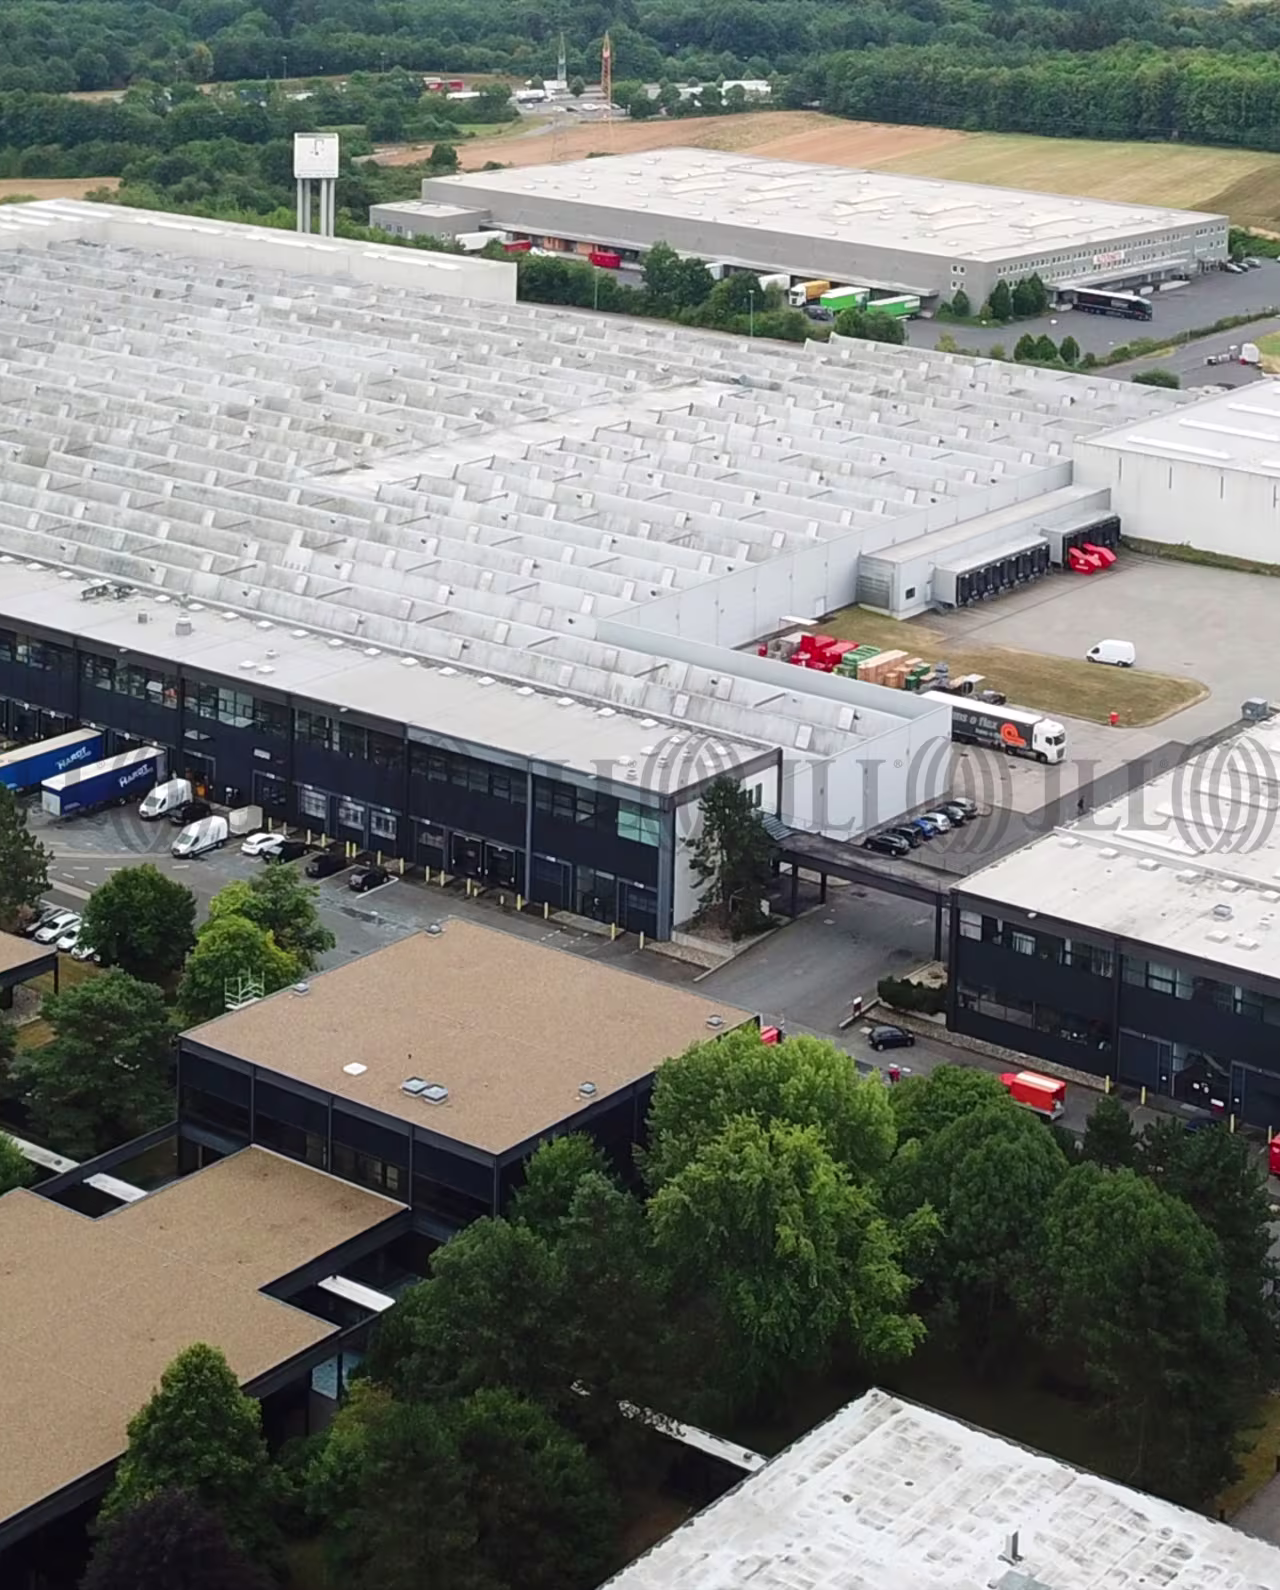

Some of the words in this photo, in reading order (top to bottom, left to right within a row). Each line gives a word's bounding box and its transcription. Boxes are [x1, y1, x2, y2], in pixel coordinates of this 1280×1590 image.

[978, 716, 999, 729] flex
[56, 746, 87, 770] HARDT
[118, 763, 149, 788] HARDT
